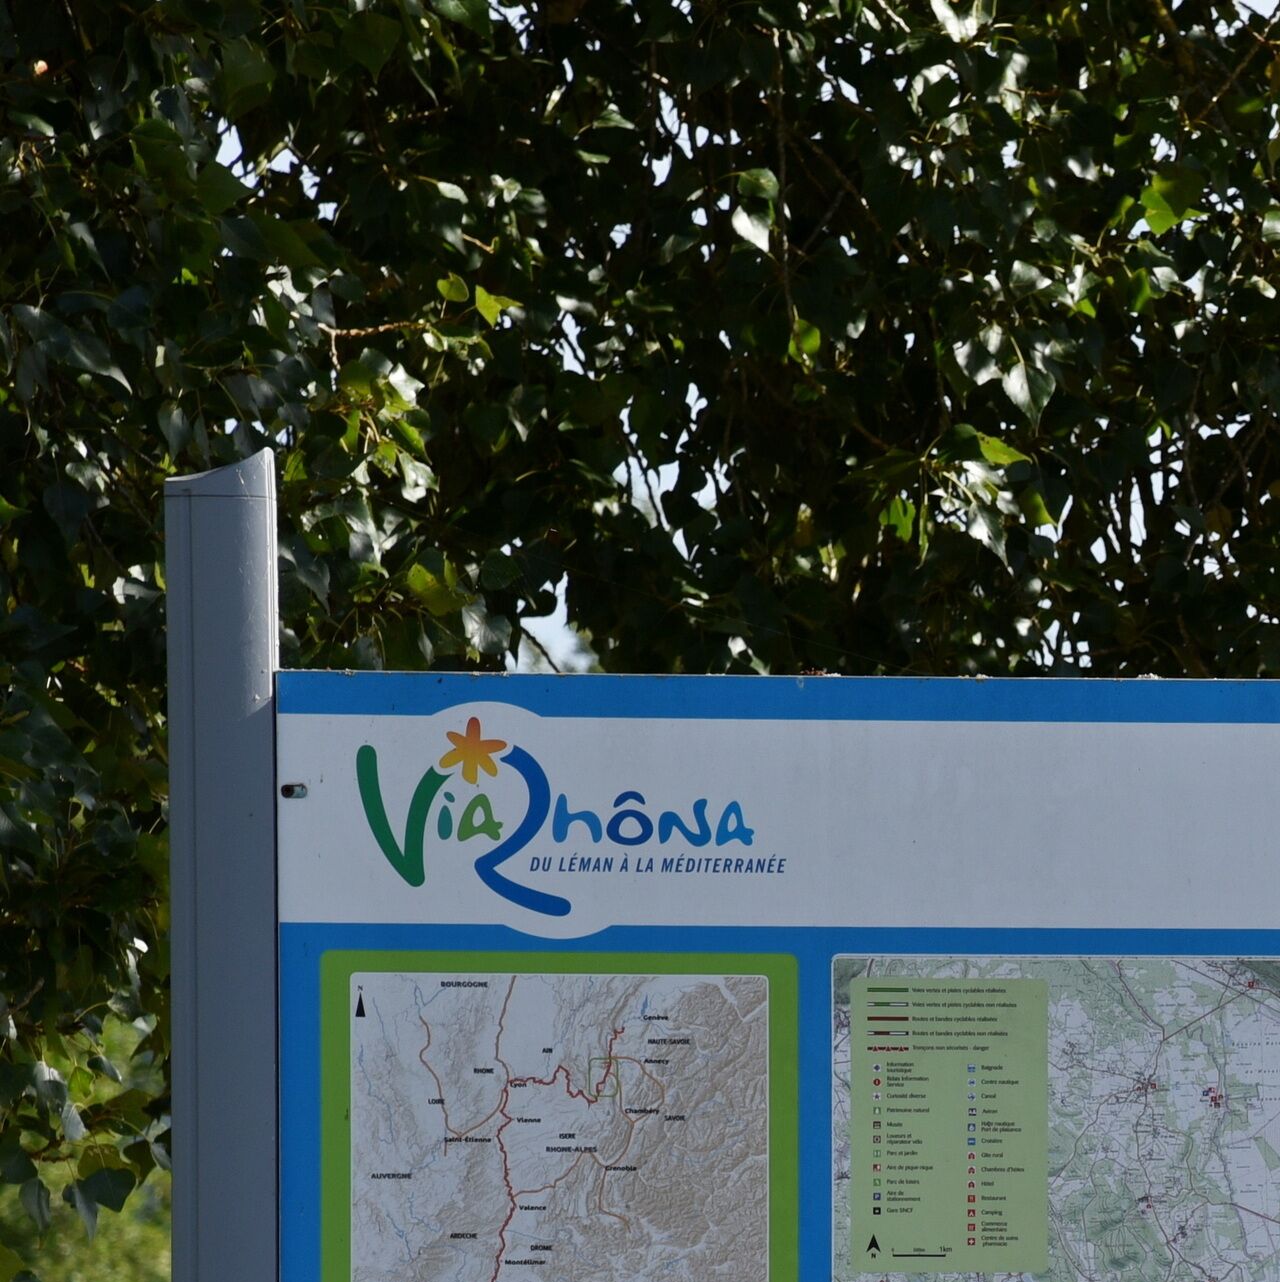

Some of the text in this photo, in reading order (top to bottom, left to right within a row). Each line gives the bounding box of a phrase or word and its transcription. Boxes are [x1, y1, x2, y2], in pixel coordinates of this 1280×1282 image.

[530, 853, 787, 874] DU LÉMAN À LA MÉDITERRANÉE
